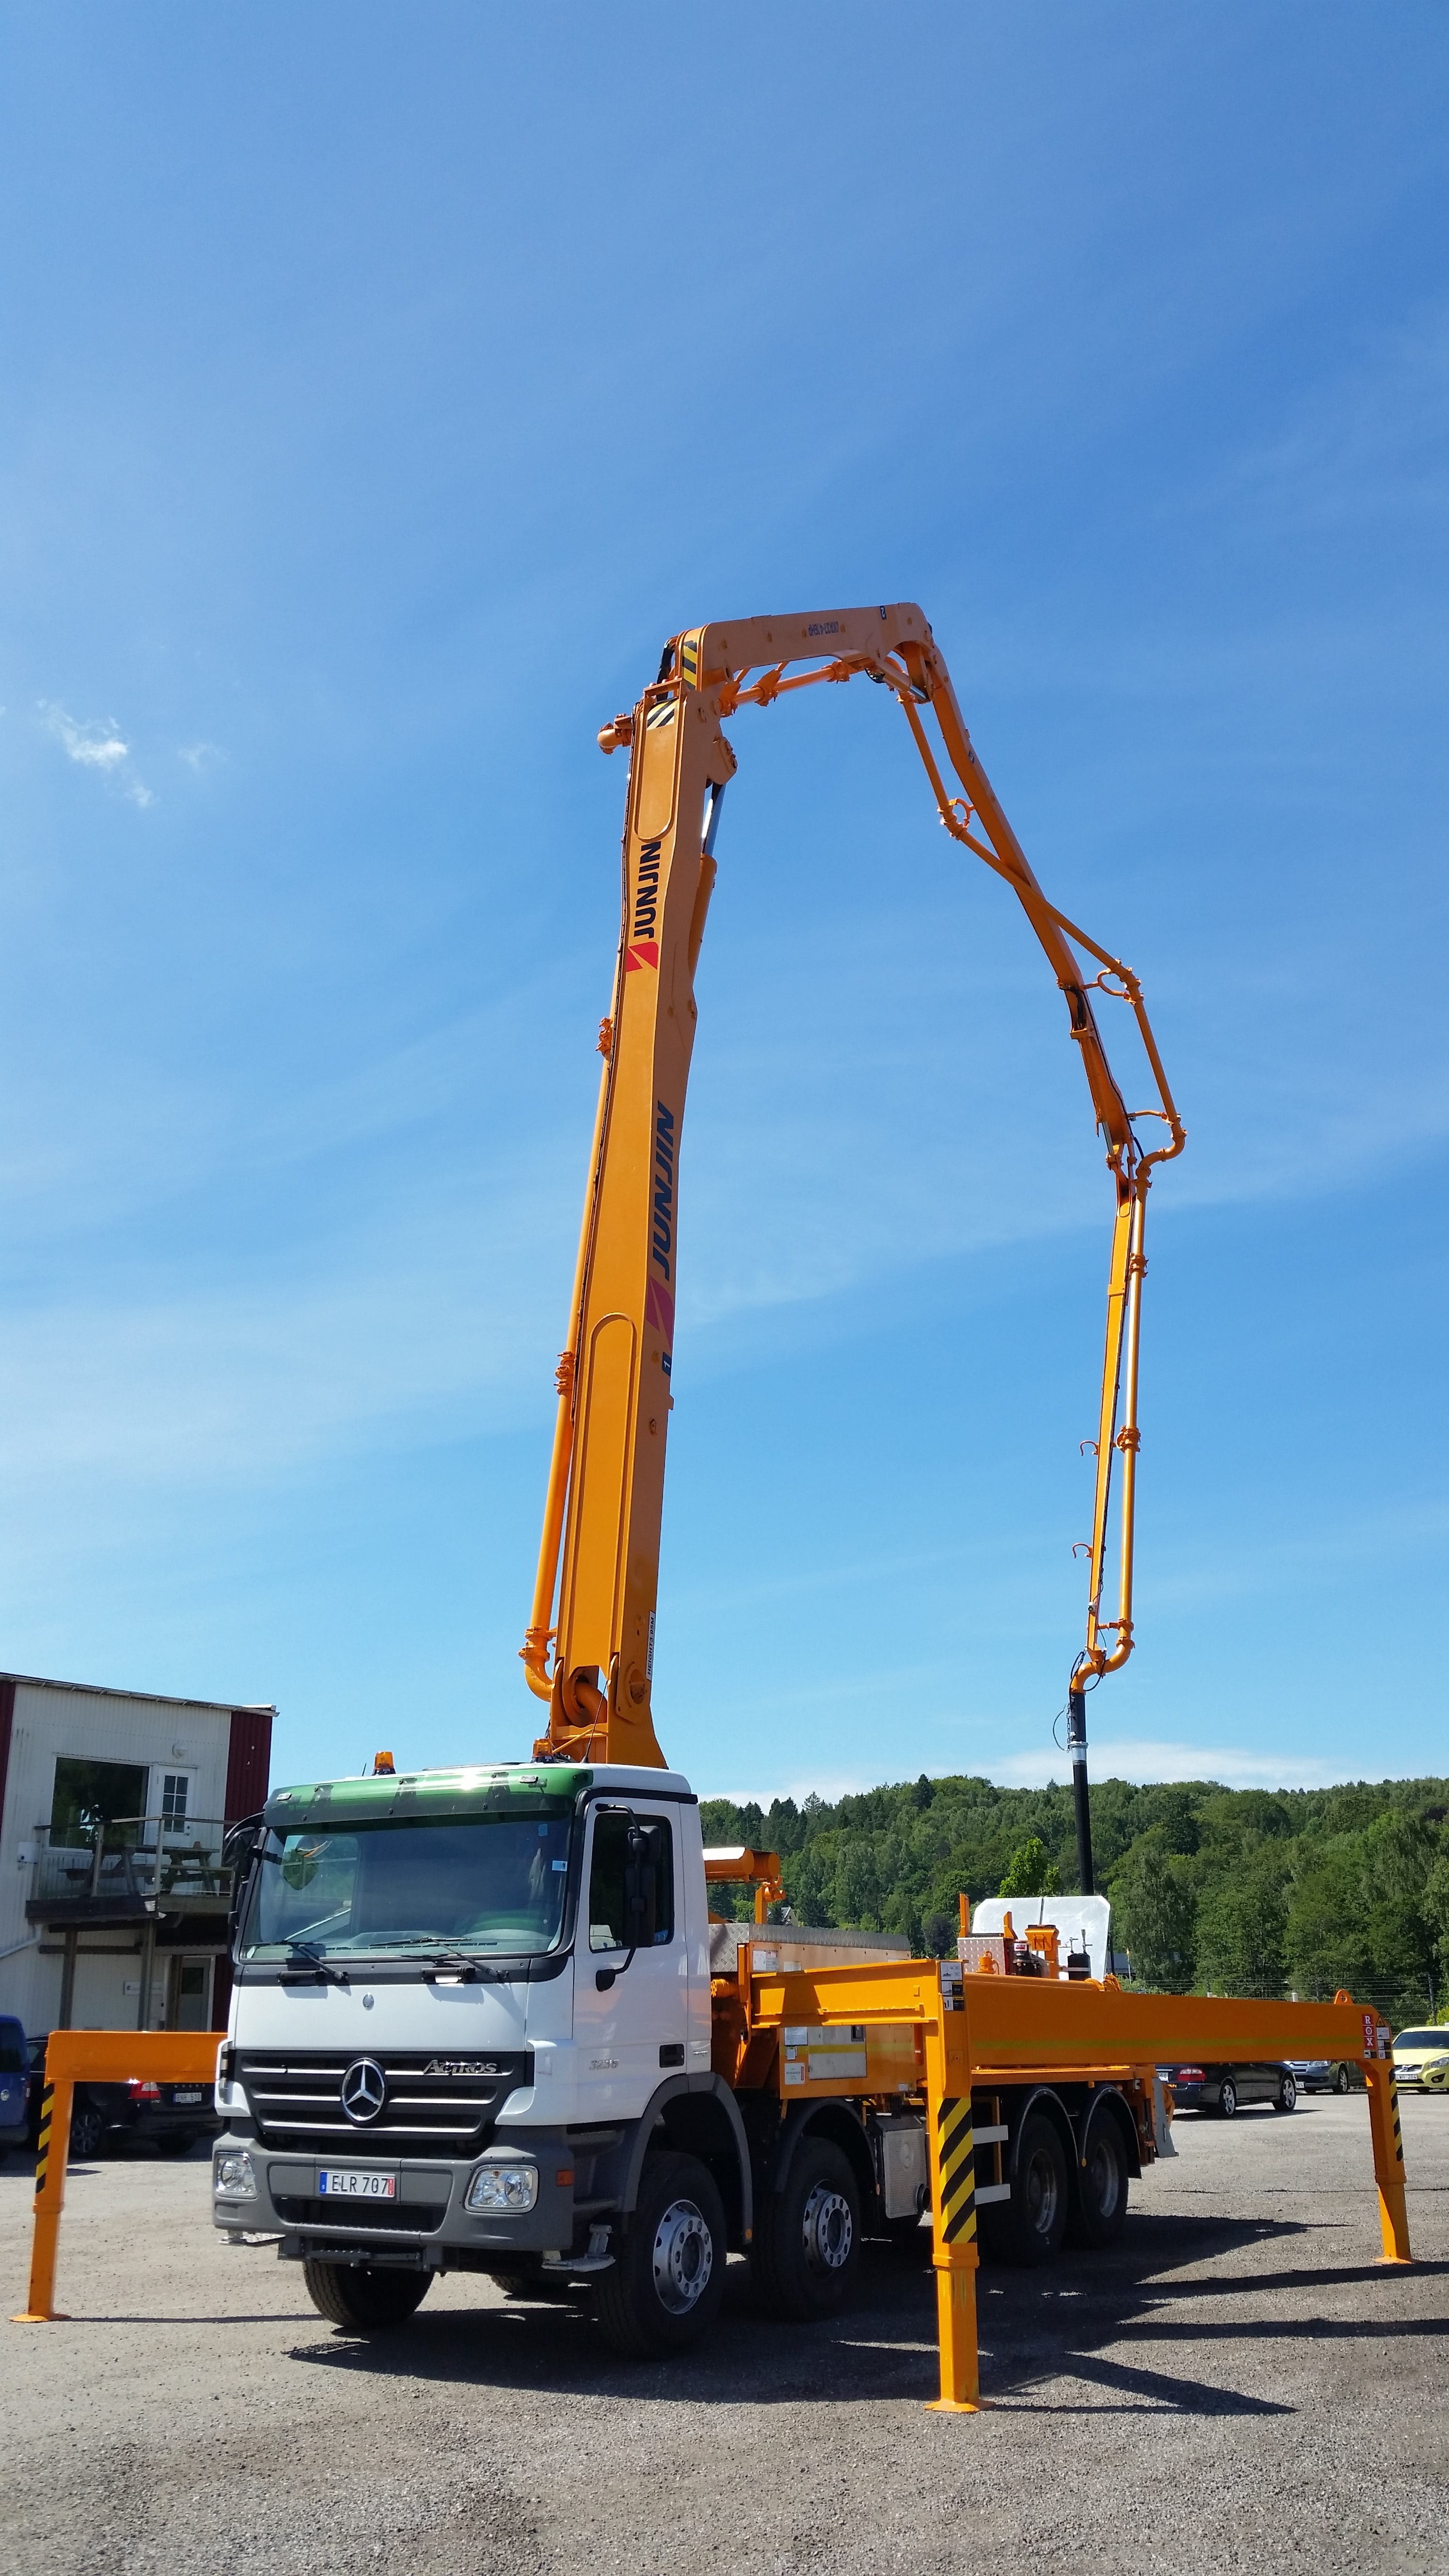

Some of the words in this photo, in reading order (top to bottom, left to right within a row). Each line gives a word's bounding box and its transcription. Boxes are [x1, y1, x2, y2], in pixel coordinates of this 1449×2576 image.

[880, 607, 886, 617] 2
[633, 840, 662, 939] JUNJIN
[652, 1099, 674, 1282] JUNJIN
[663, 1360, 671, 1368] 1
[332, 2175, 357, 2192] ELR
[362, 2176, 388, 2194] 707
